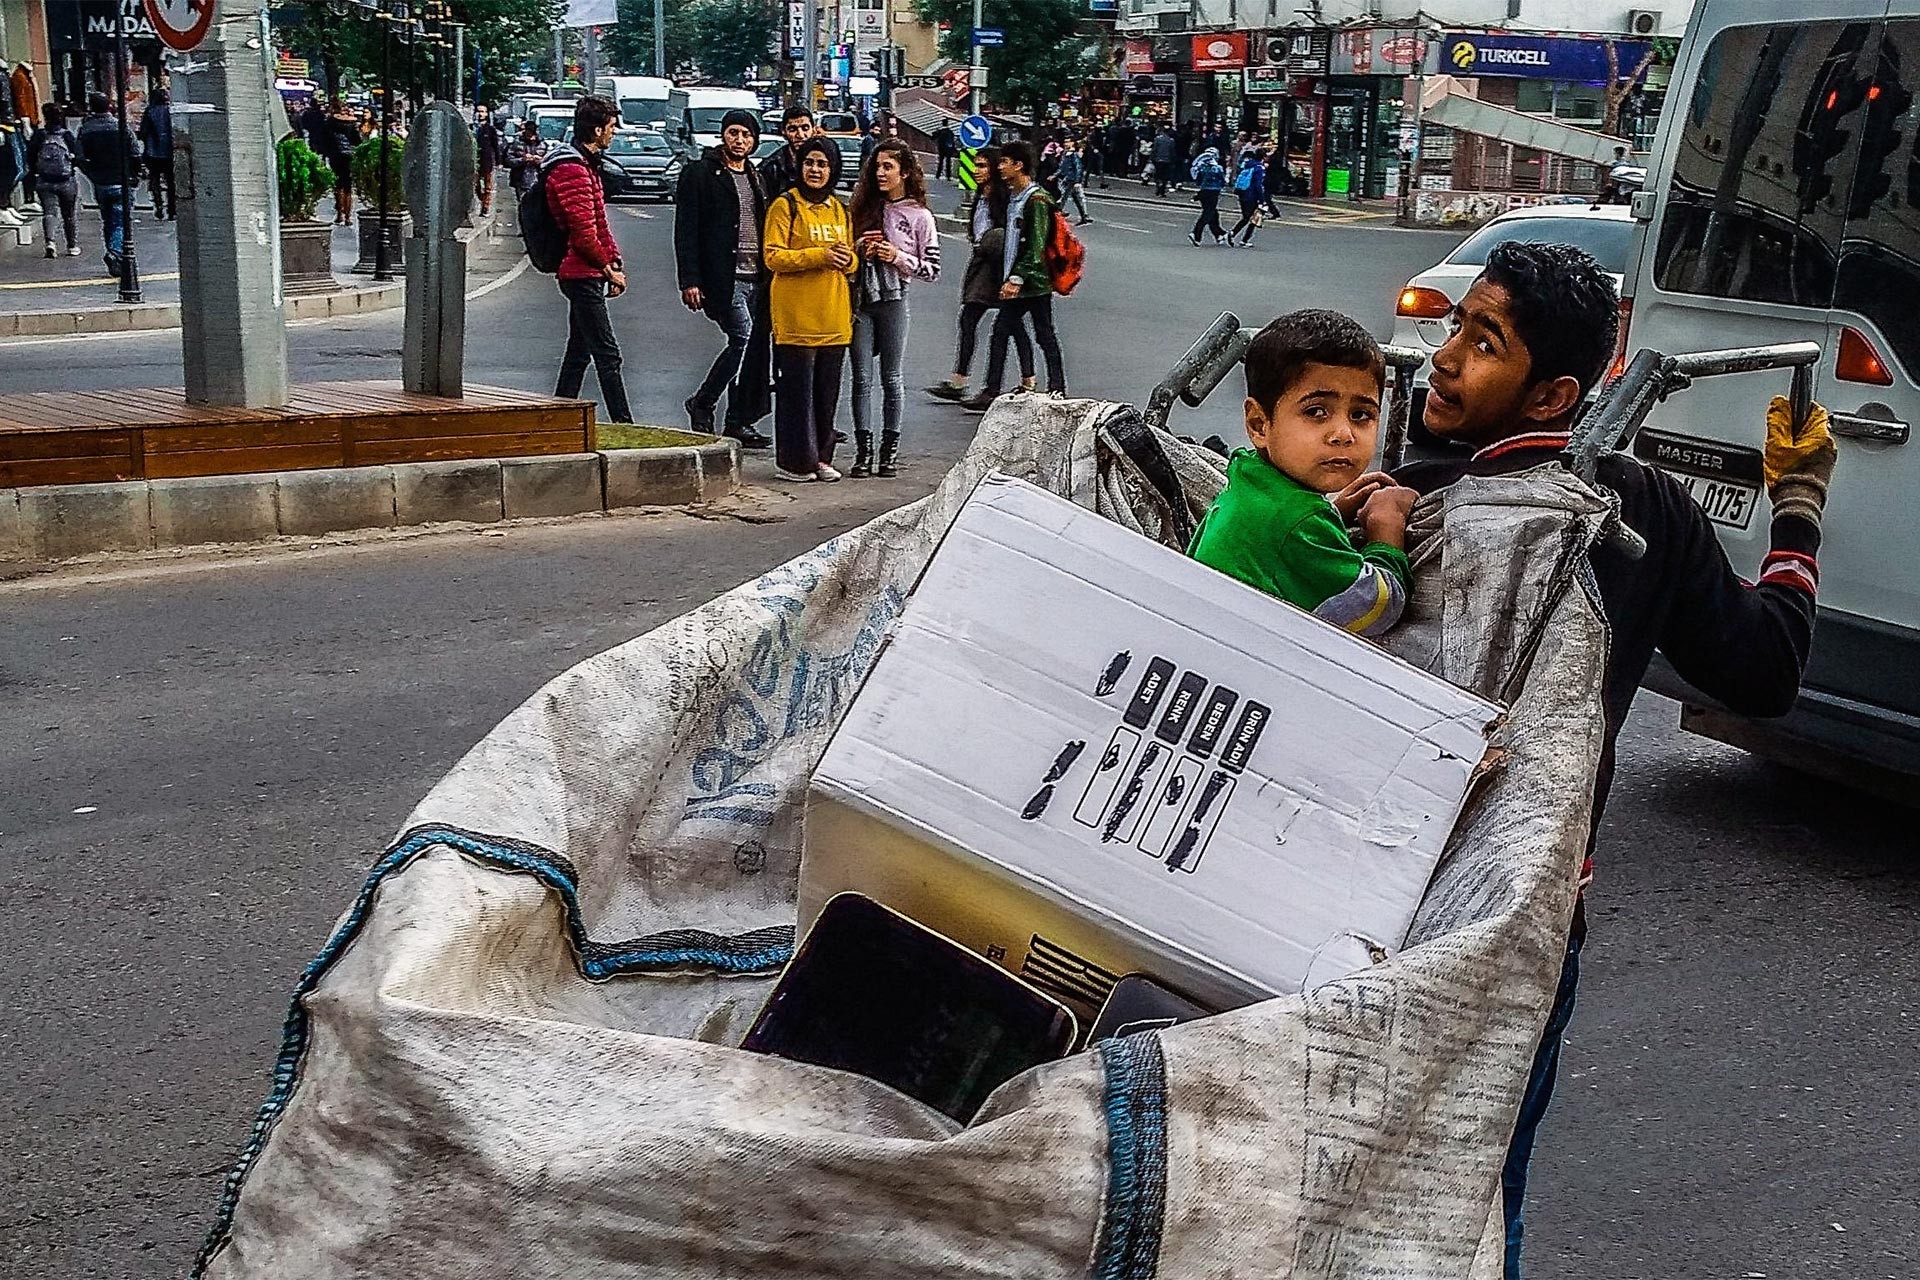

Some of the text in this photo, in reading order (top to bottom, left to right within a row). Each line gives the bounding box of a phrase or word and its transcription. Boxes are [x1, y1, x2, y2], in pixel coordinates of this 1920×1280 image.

[793, 16, 803, 46] THY
[1479, 48, 1550, 65] TURKCELL
[808, 223, 846, 242] HEY
[1657, 444, 1723, 469] MASTER
[1702, 483, 1747, 521] 0175
[1140, 672, 1162, 704] ADET
[1167, 690, 1192, 724] RENK
[1200, 702, 1227, 741] BEDEN
[1239, 710, 1263, 743] ÜRÜN
